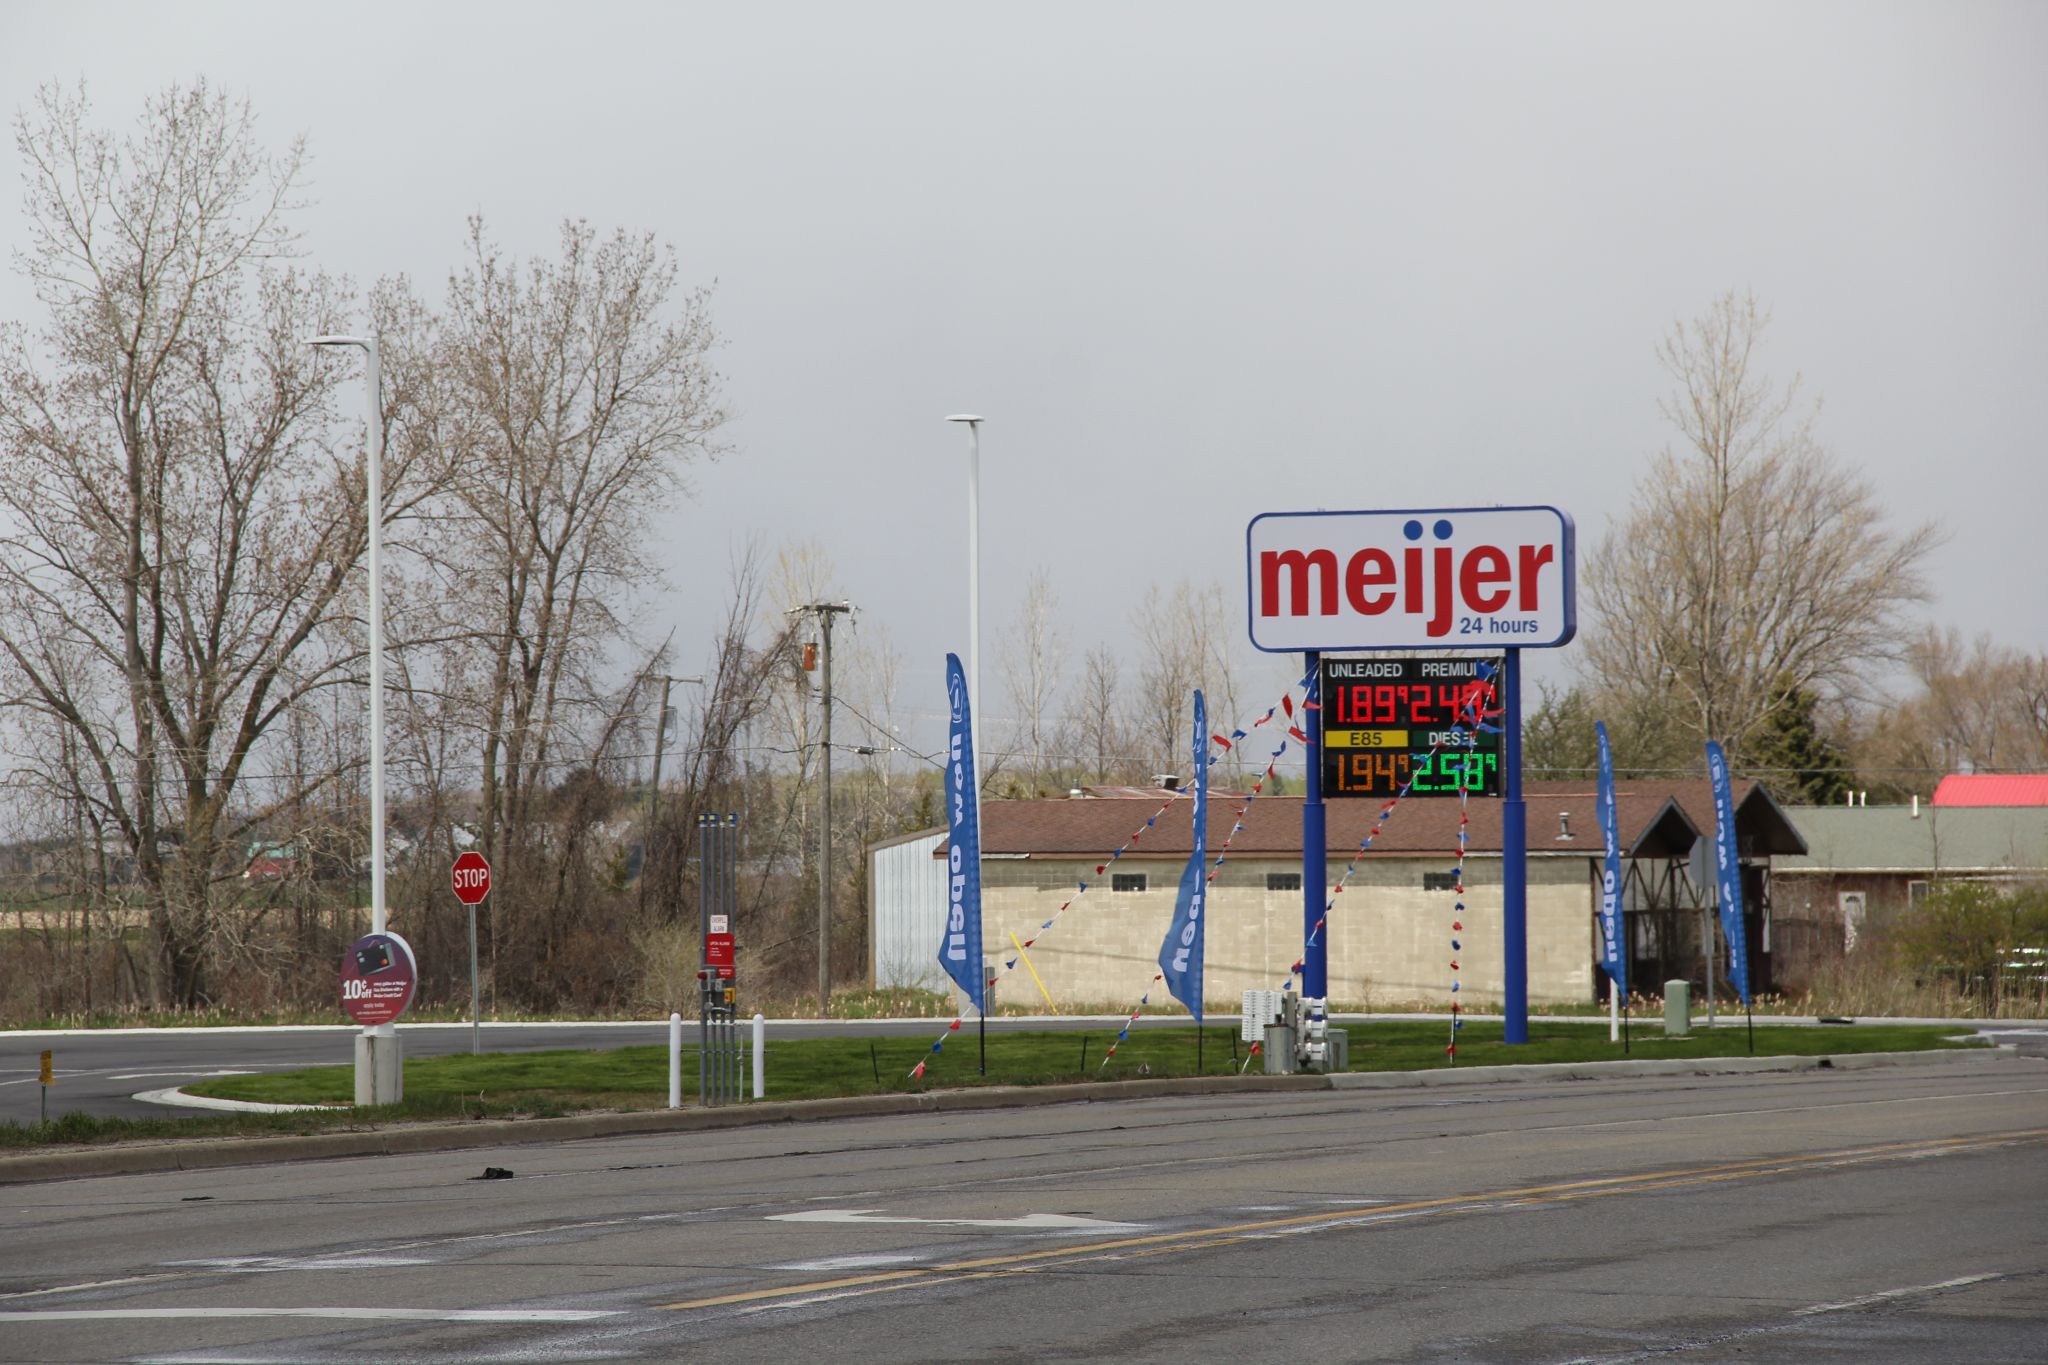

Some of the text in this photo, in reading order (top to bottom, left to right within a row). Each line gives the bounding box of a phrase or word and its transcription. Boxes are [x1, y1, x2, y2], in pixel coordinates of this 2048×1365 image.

[1260, 519, 1553, 637] meijer
[1460, 617, 1538, 634] 24 hours
[1329, 663, 1403, 677] UNLEADED
[1422, 662, 1477, 677] PREMIU
[1350, 733, 1382, 746] E85
[454, 868, 488, 889] STOP
[361, 988, 372, 999] off
